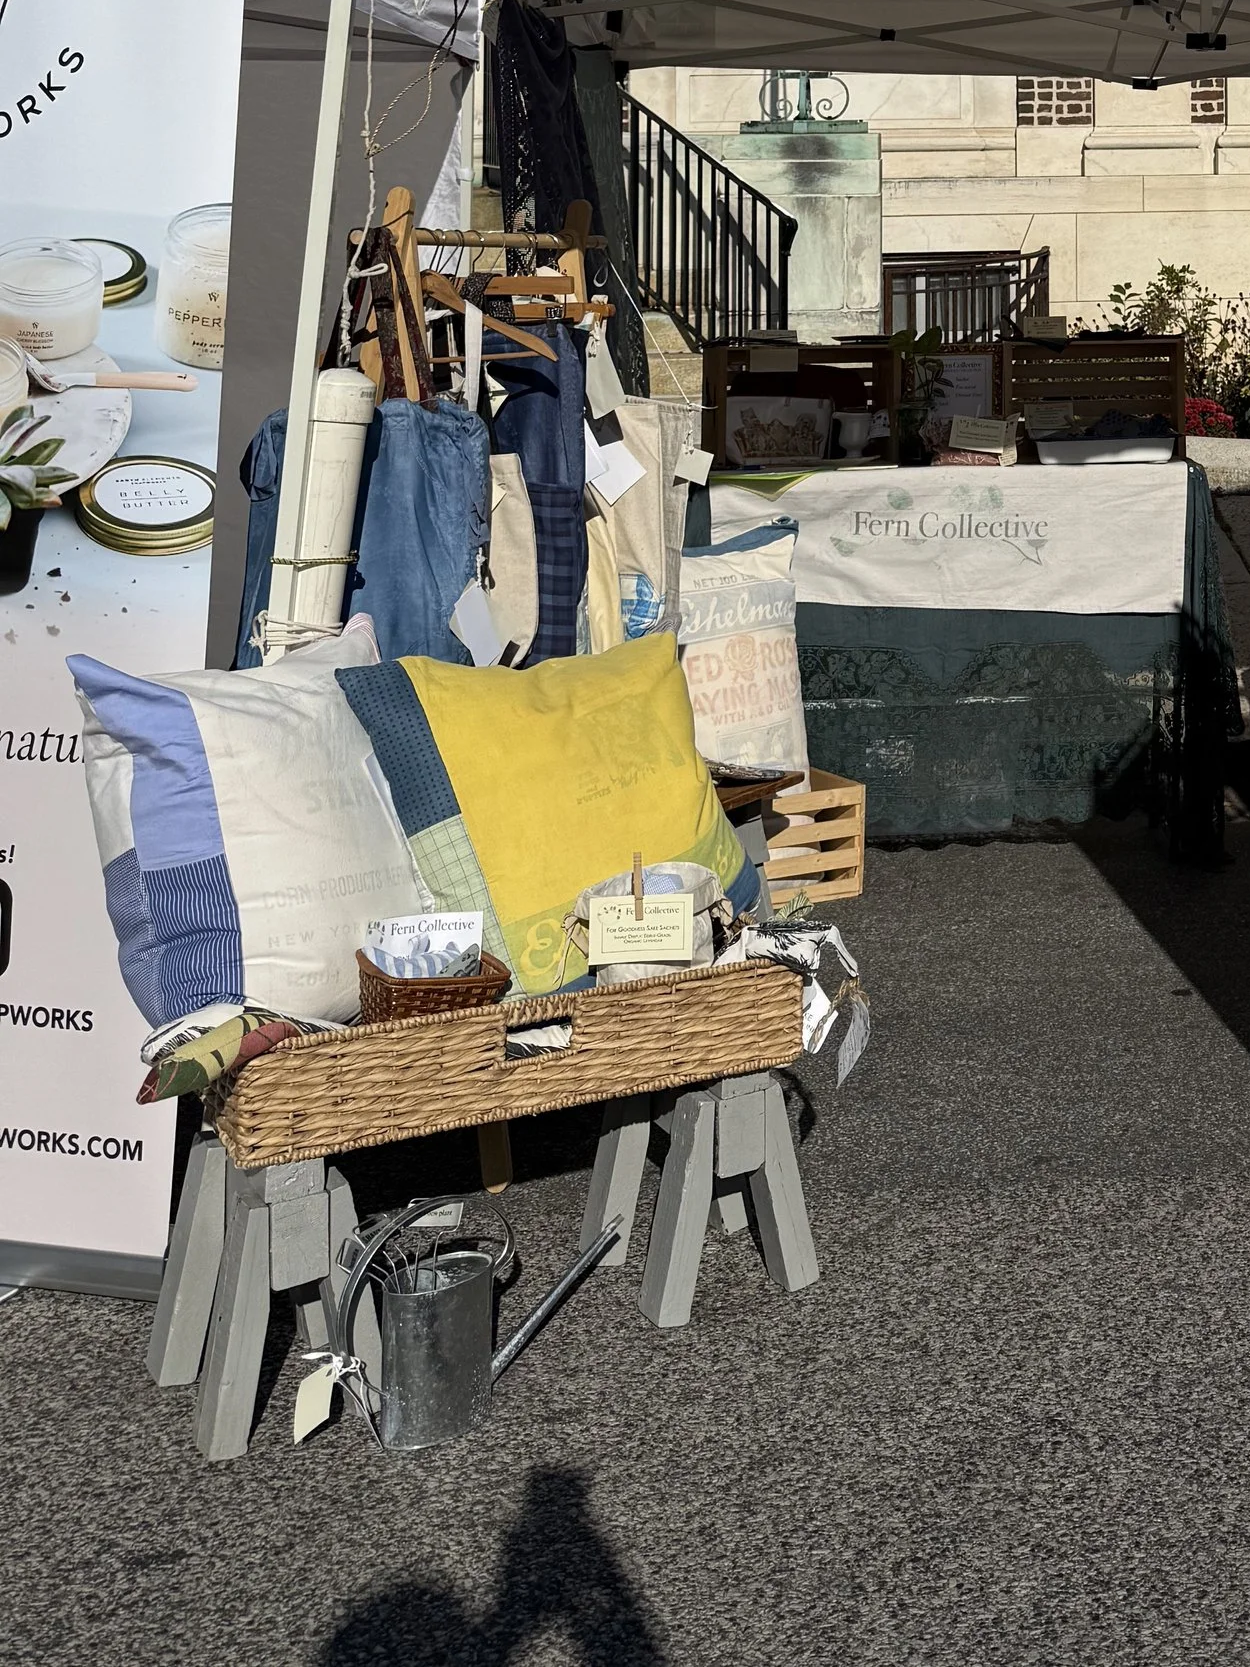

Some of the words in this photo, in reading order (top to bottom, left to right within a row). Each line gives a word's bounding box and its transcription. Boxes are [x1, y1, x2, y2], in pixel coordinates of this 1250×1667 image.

[119, 488, 184, 497] BELLY
[123, 499, 189, 509] BUTTER
[852, 511, 911, 538] Fern
[919, 511, 1049, 539] Collective
[693, 577, 717, 590] NET
[718, 574, 738, 586] 100
[711, 710, 745, 726] WITH
[0, 726, 84, 763] natu
[319, 871, 383, 901] PRODUCTS
[644, 906, 680, 915] Collective
[391, 922, 415, 936] Fern
[418, 919, 475, 933] Collective
[268, 931, 314, 948] NEW
